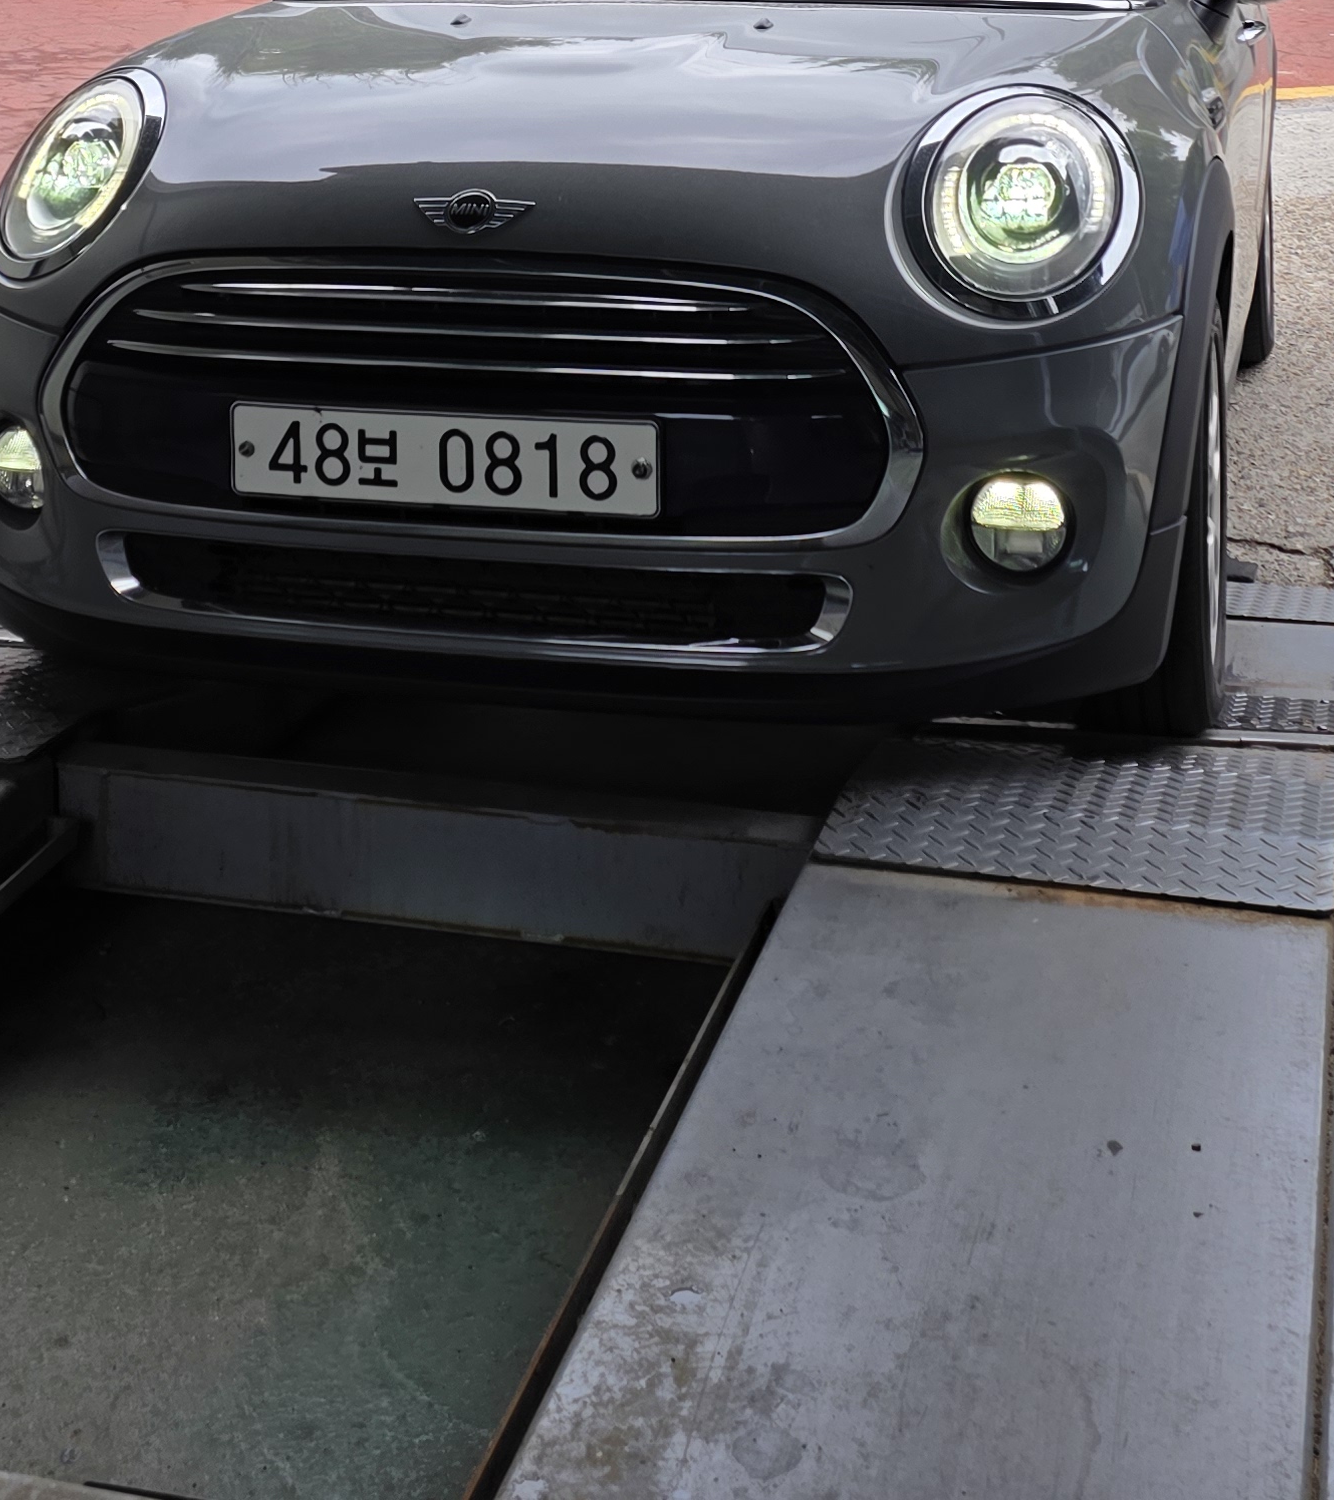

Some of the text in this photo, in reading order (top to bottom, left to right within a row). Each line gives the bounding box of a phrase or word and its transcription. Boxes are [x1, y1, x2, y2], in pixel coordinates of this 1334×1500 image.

[450, 202, 490, 217] MINI
[266, 419, 619, 501] 48보 0818
